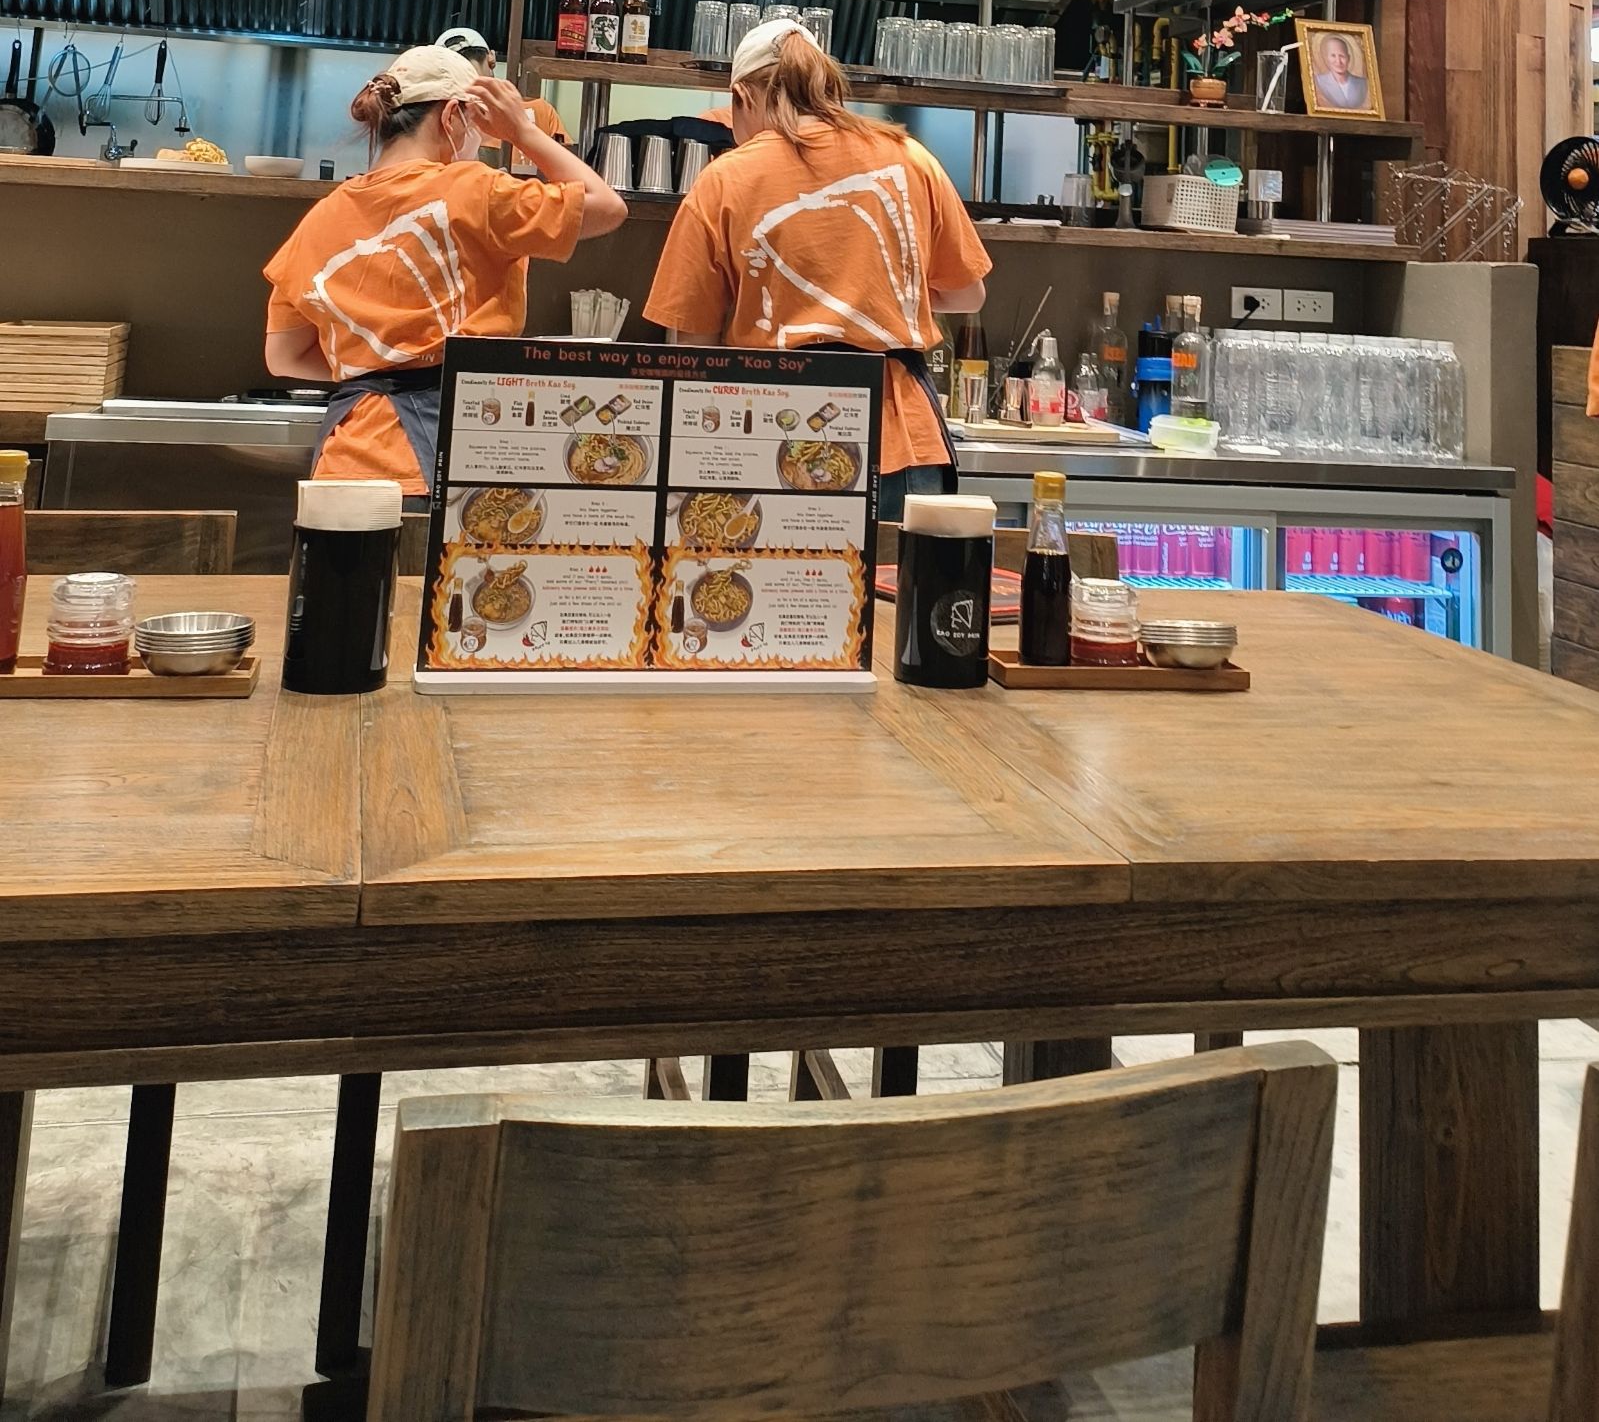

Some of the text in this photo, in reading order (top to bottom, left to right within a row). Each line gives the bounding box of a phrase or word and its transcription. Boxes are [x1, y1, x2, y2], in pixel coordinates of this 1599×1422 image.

[523, 346, 551, 361] The
[559, 348, 592, 362] best
[600, 351, 629, 366] way
[636, 351, 651, 364] to
[658, 352, 700, 369] enjoy
[706, 355, 730, 368] our
[496, 377, 524, 387] LIGHT
[525, 379, 546, 387] Broth
[547, 380, 561, 388] Kao
[712, 385, 740, 396] CURRY
